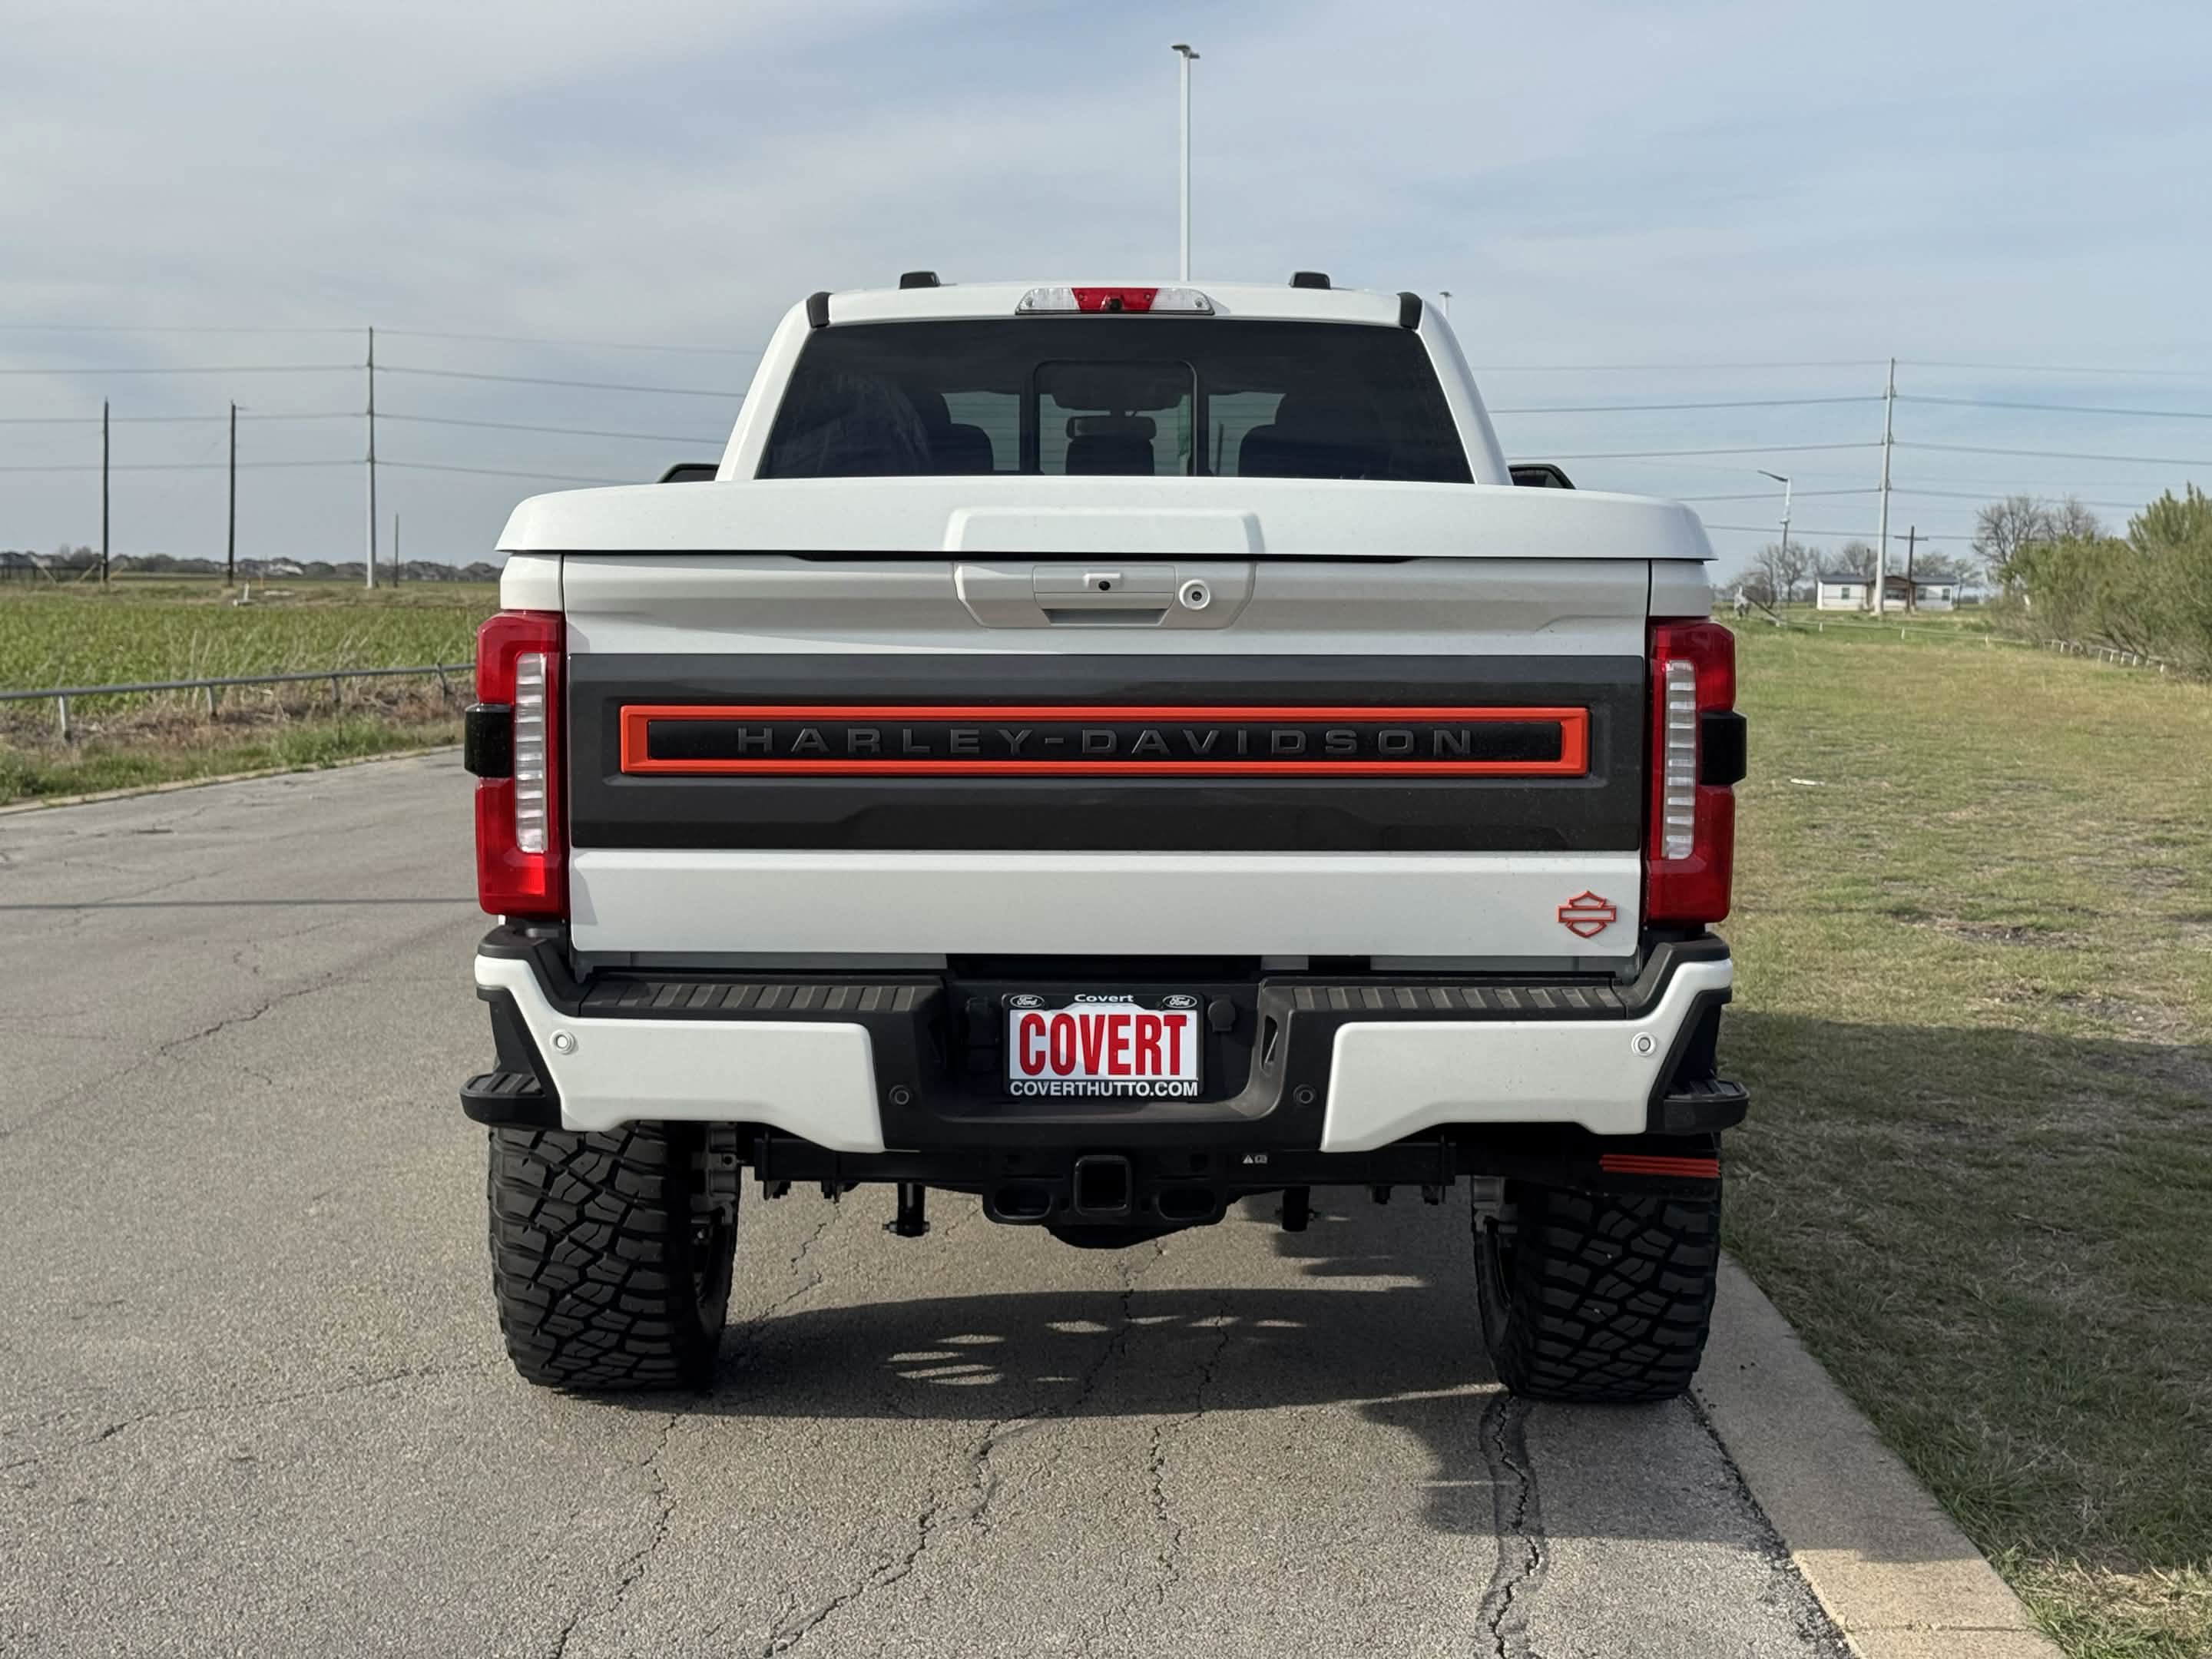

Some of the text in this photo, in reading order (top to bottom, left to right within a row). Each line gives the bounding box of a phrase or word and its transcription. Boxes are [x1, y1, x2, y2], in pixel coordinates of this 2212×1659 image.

[738, 727, 1471, 754] HARLEY-DAVIDSON
[1015, 995, 1039, 1006] Ford
[1075, 994, 1134, 1002] Covert
[1169, 995, 1192, 1006] Ford
[1019, 1013, 1187, 1076] COVERT
[1010, 1081, 1198, 1096] COVERTHUTTO.COM
